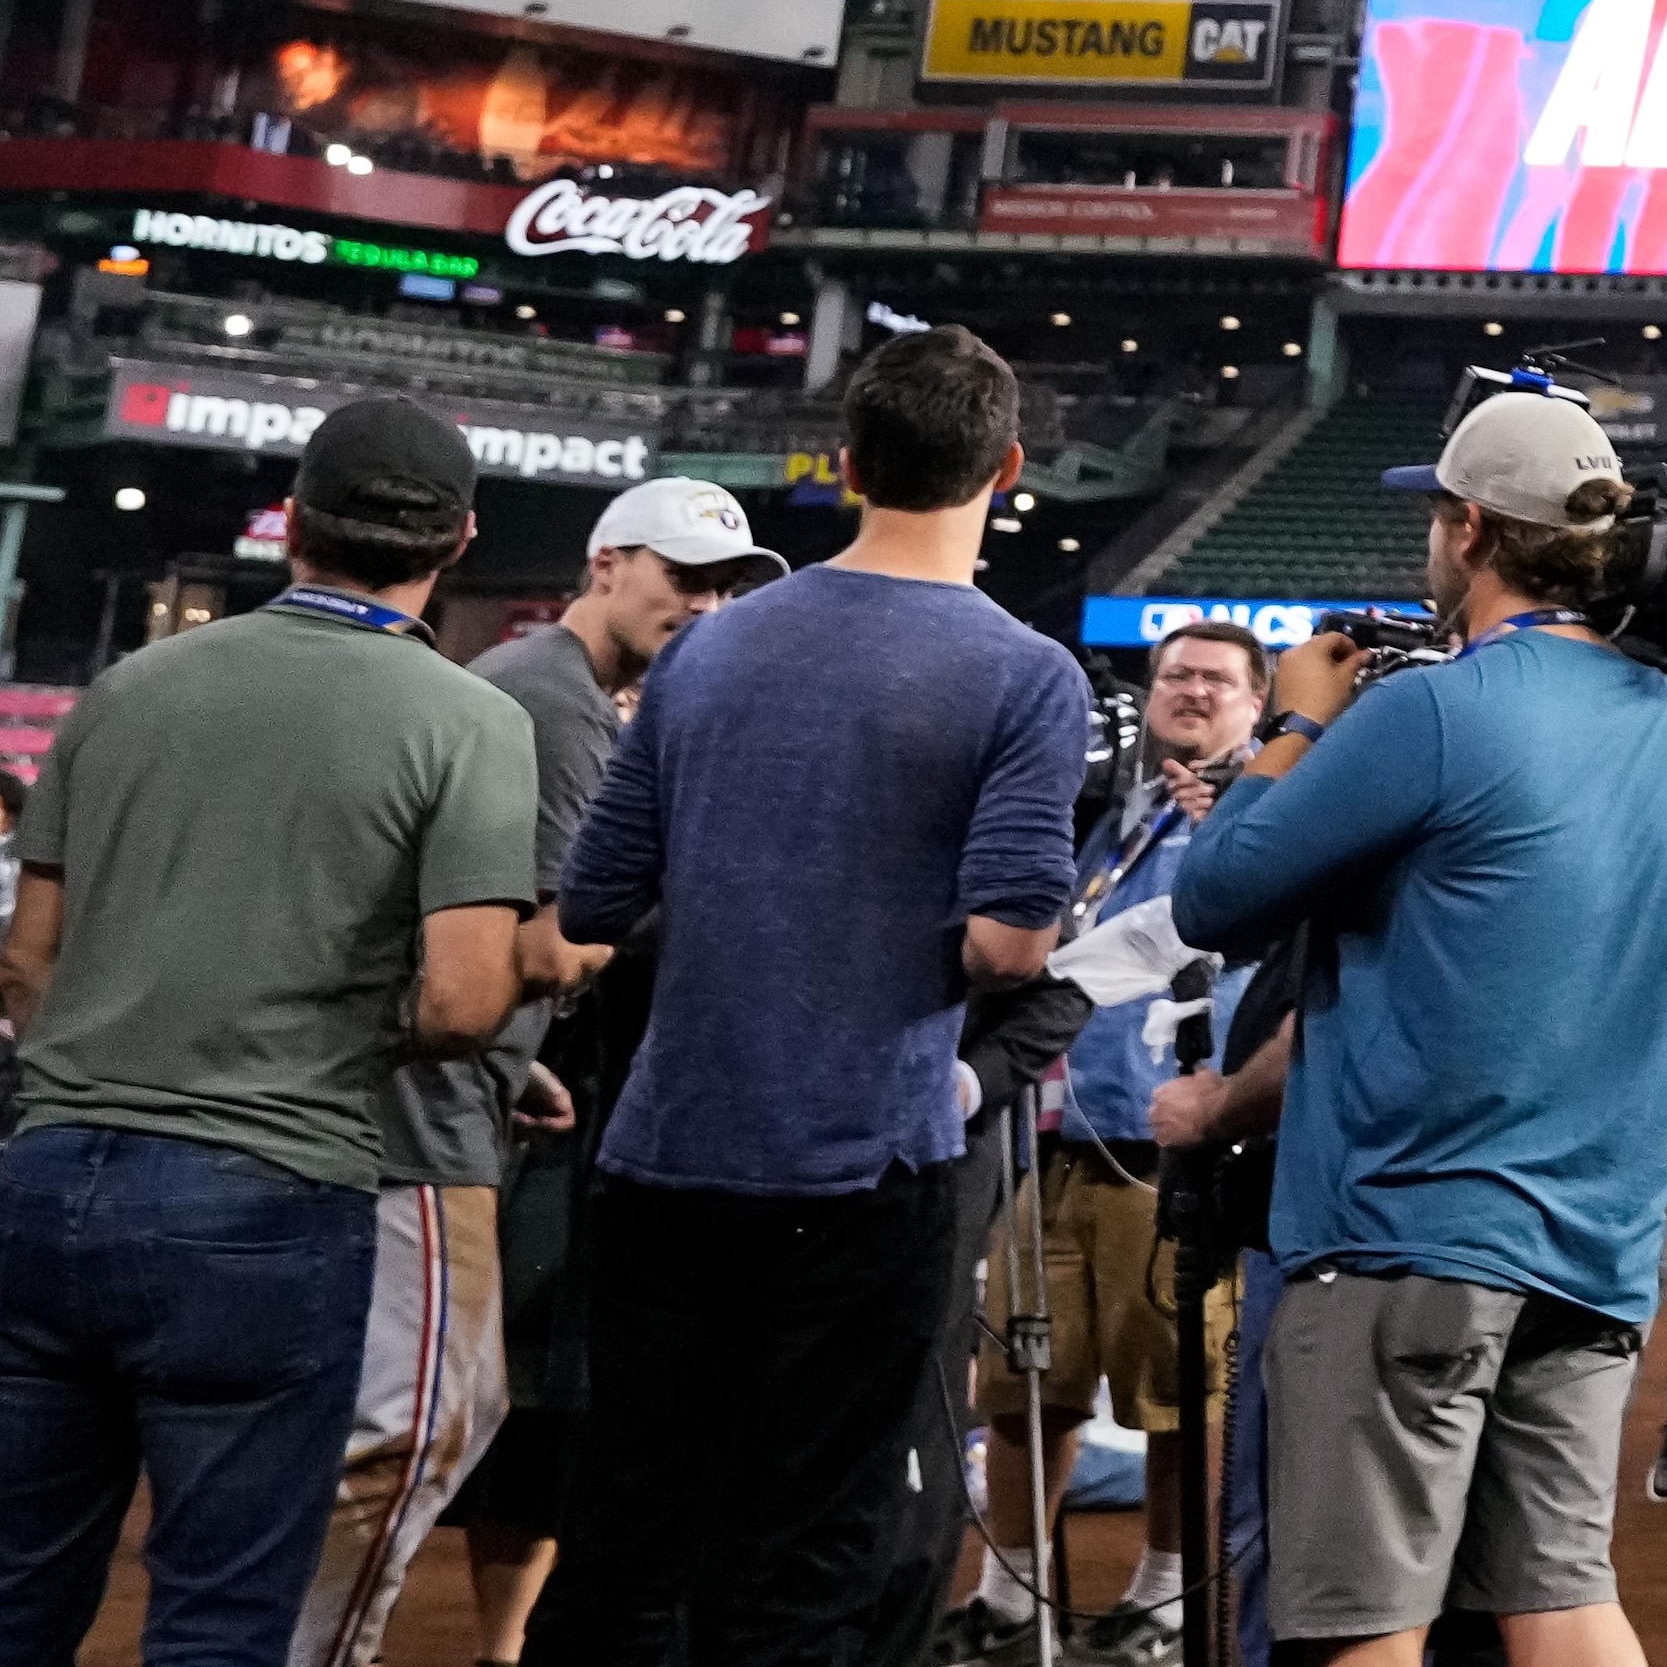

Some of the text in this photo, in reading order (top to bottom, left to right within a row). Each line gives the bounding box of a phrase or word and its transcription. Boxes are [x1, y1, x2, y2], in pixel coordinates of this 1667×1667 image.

[967, 17, 1268, 65] MUSTANG CAT
[133, 208, 331, 265] HORNITOS
[166, 384, 326, 446] impa
[456, 416, 649, 478] mpact
